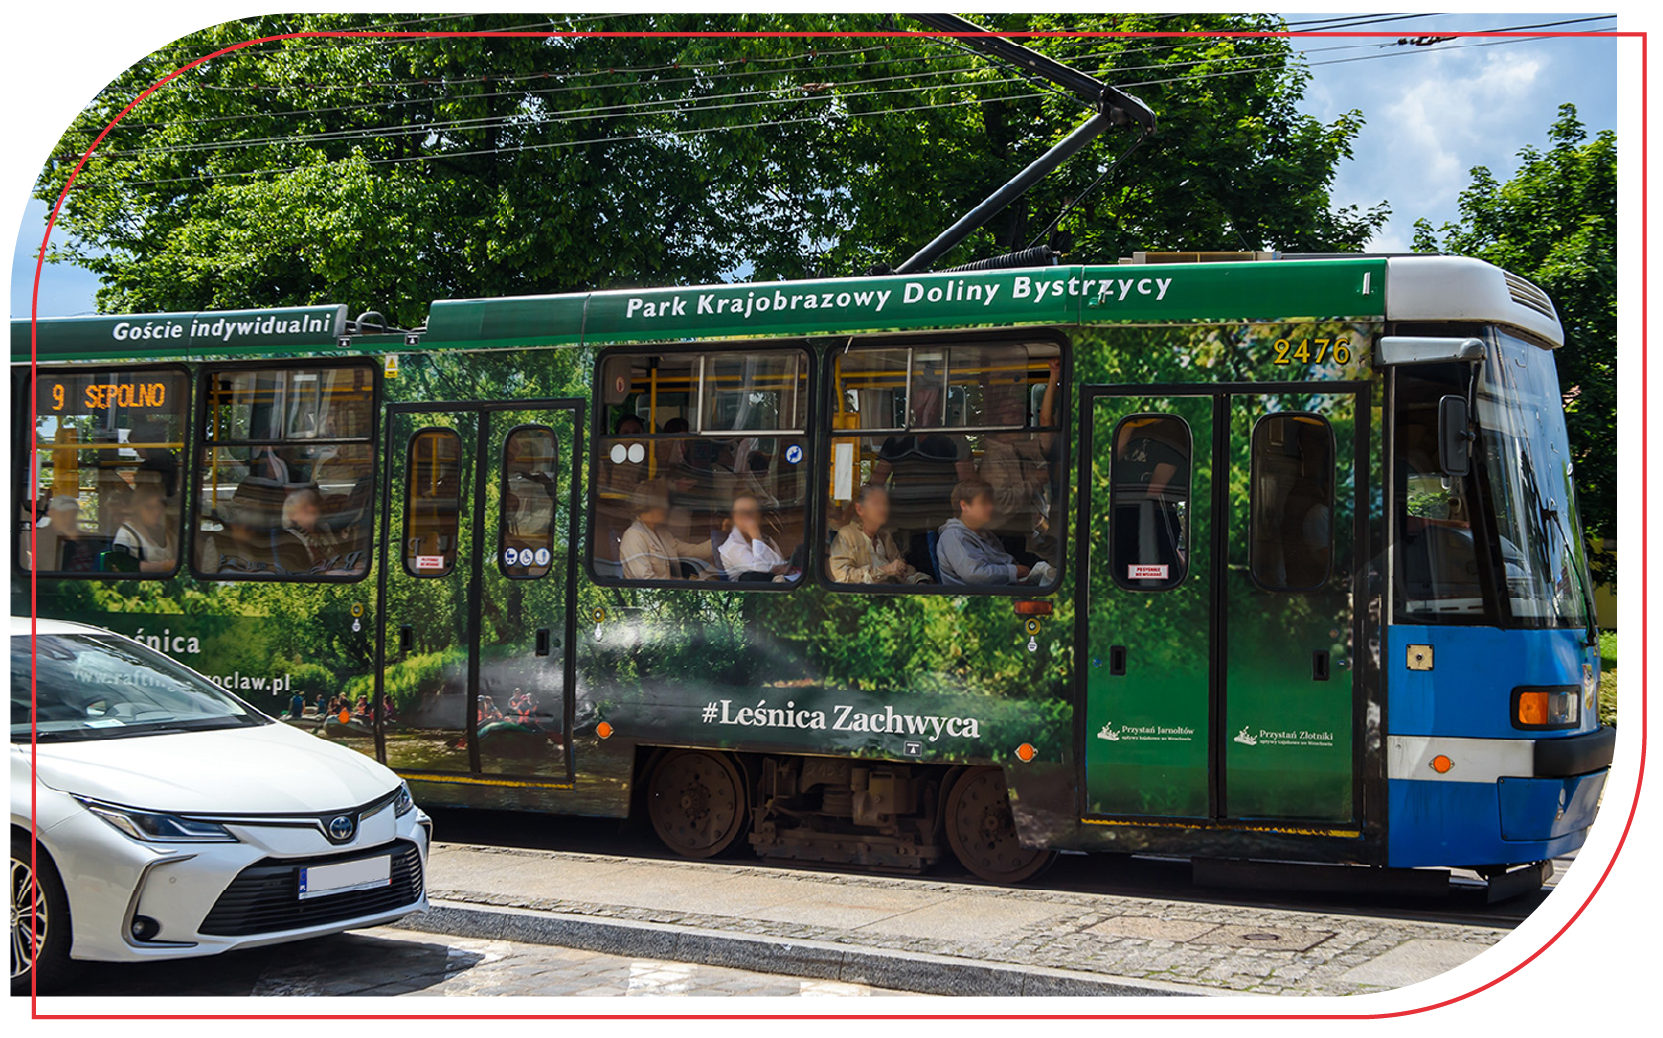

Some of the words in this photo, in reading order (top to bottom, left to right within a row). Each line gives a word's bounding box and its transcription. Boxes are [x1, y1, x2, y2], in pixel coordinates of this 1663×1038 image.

[626, 296, 687, 318] Park
[697, 290, 891, 319] Krajobrazowy
[903, 279, 1001, 306] Doliny
[1012, 276, 1172, 303] Bystrzycy
[112, 321, 183, 341] Goście
[190, 313, 331, 341] indywidualni
[1273, 338, 1351, 364] 2476
[52, 383, 65, 411] 9
[702, 698, 827, 729] #Leśnica
[832, 704, 981, 742] Zachwyca
[1121, 725, 1155, 735] Przystań
[1260, 729, 1297, 741] Przystań
